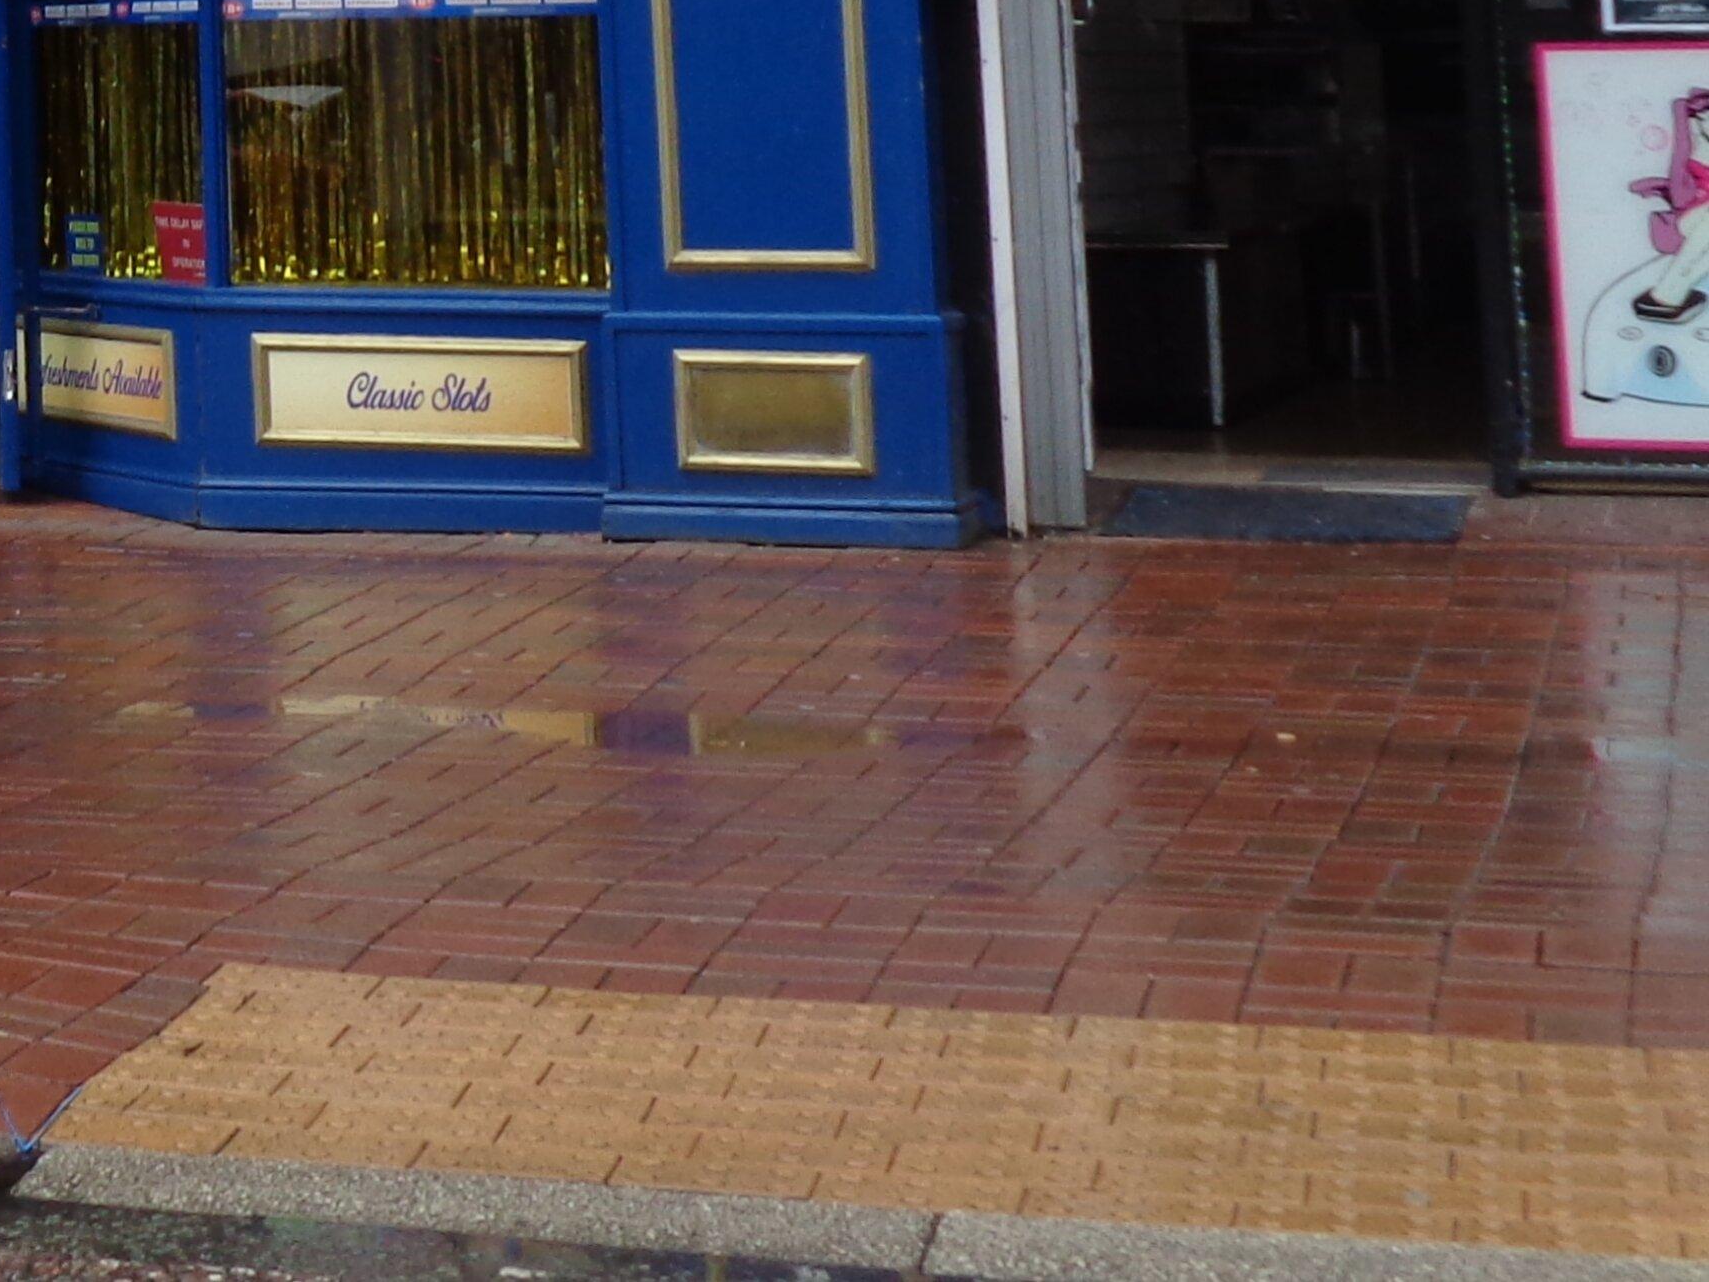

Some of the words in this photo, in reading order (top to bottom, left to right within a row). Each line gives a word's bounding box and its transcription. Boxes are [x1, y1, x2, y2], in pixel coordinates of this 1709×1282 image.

[102, 358, 164, 400] Available
[346, 371, 425, 411] Classic
[431, 372, 492, 414] Slots
